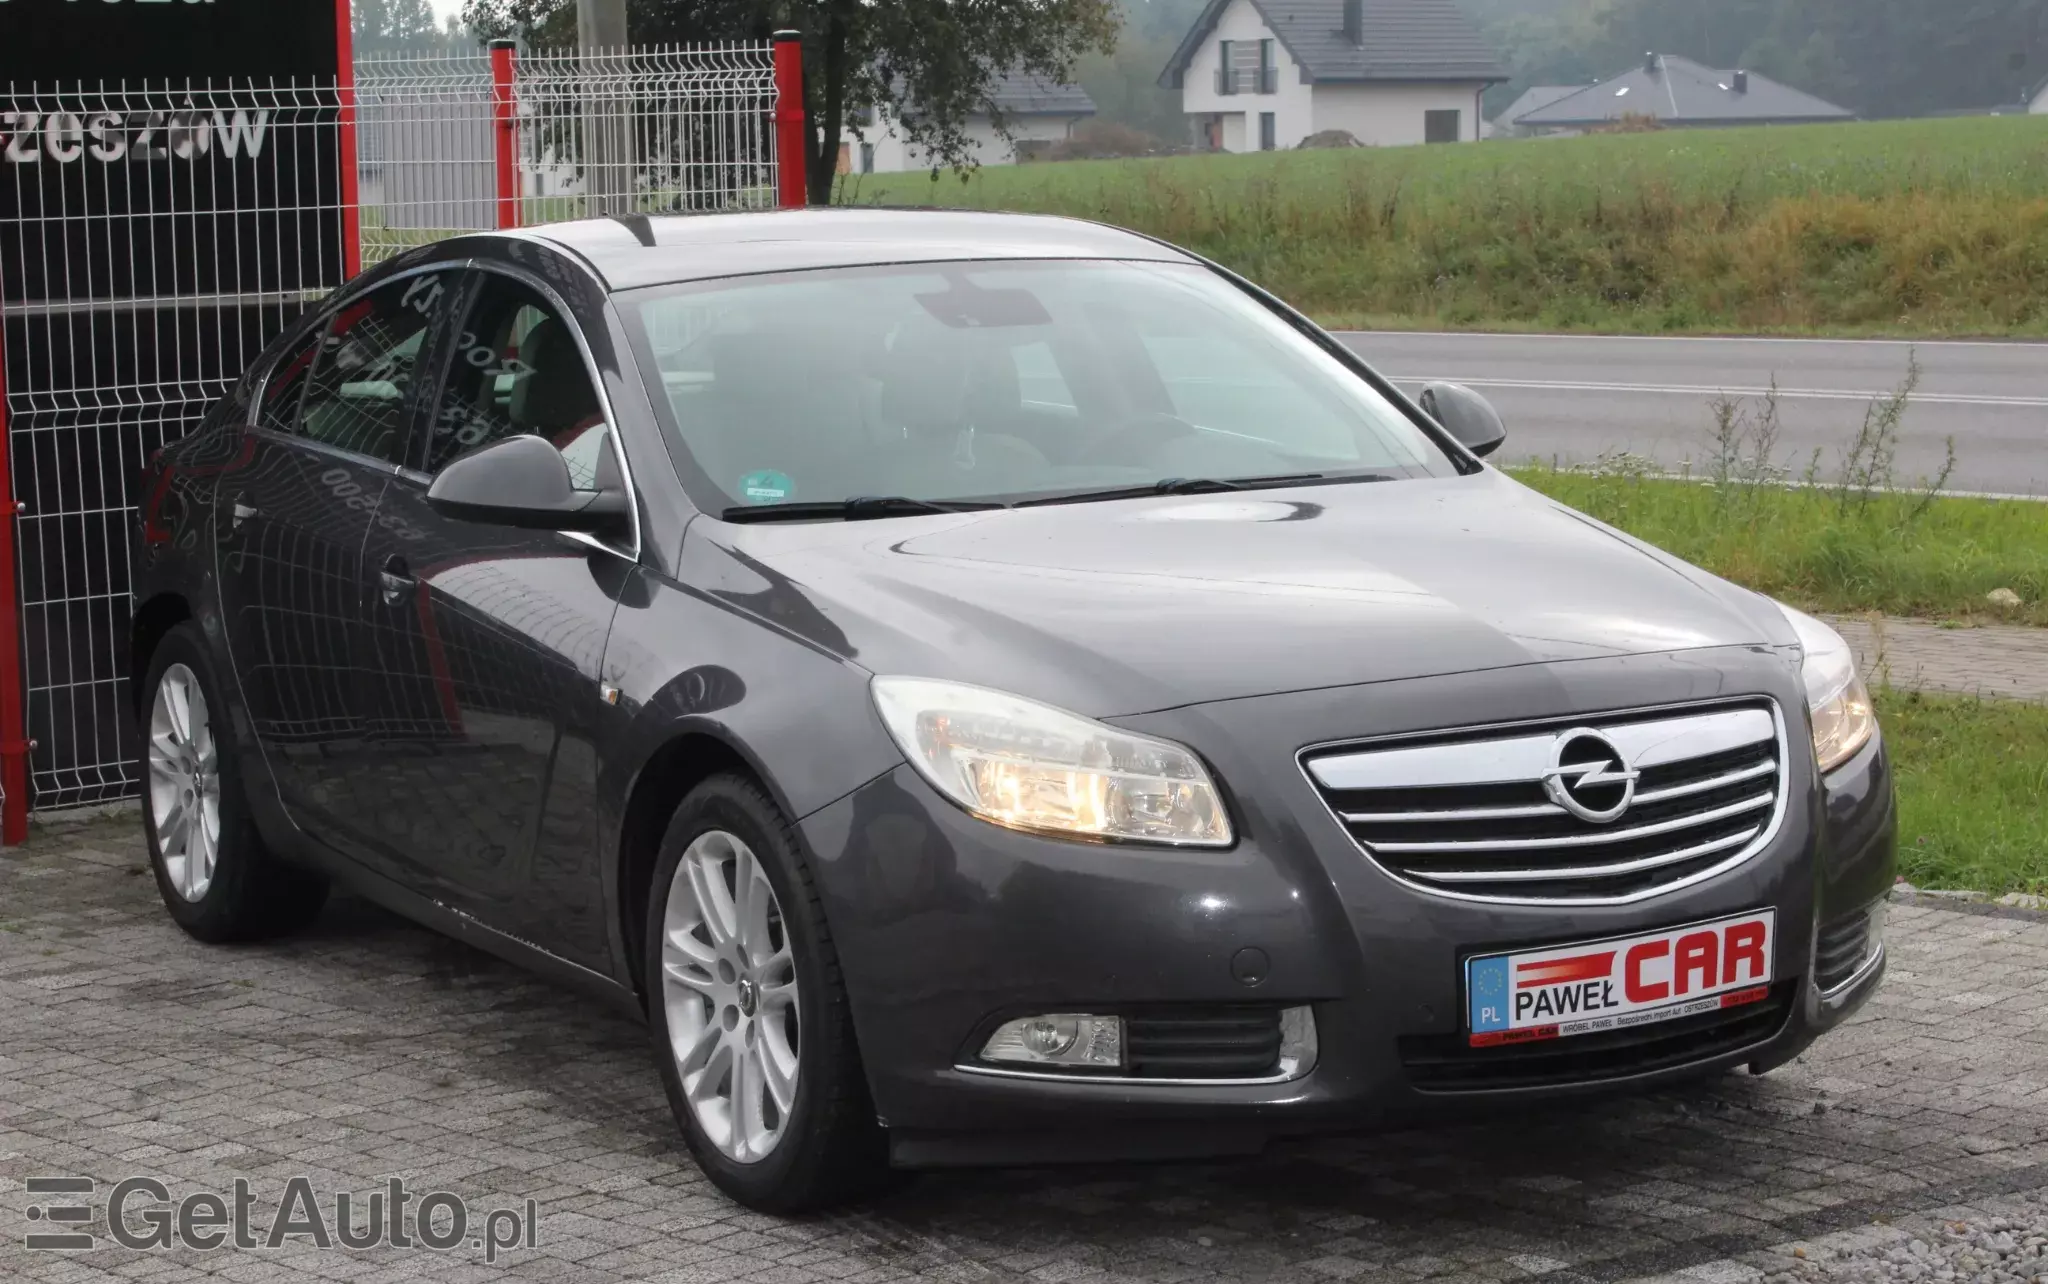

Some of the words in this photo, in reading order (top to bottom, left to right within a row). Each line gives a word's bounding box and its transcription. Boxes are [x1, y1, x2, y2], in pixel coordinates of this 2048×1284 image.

[1625, 920, 1767, 1004] CAR
[1481, 1006, 1501, 1024] PL
[1516, 980, 1619, 1021] PAWEŁ
[1562, 1021, 1590, 1033] WRÓBEL
